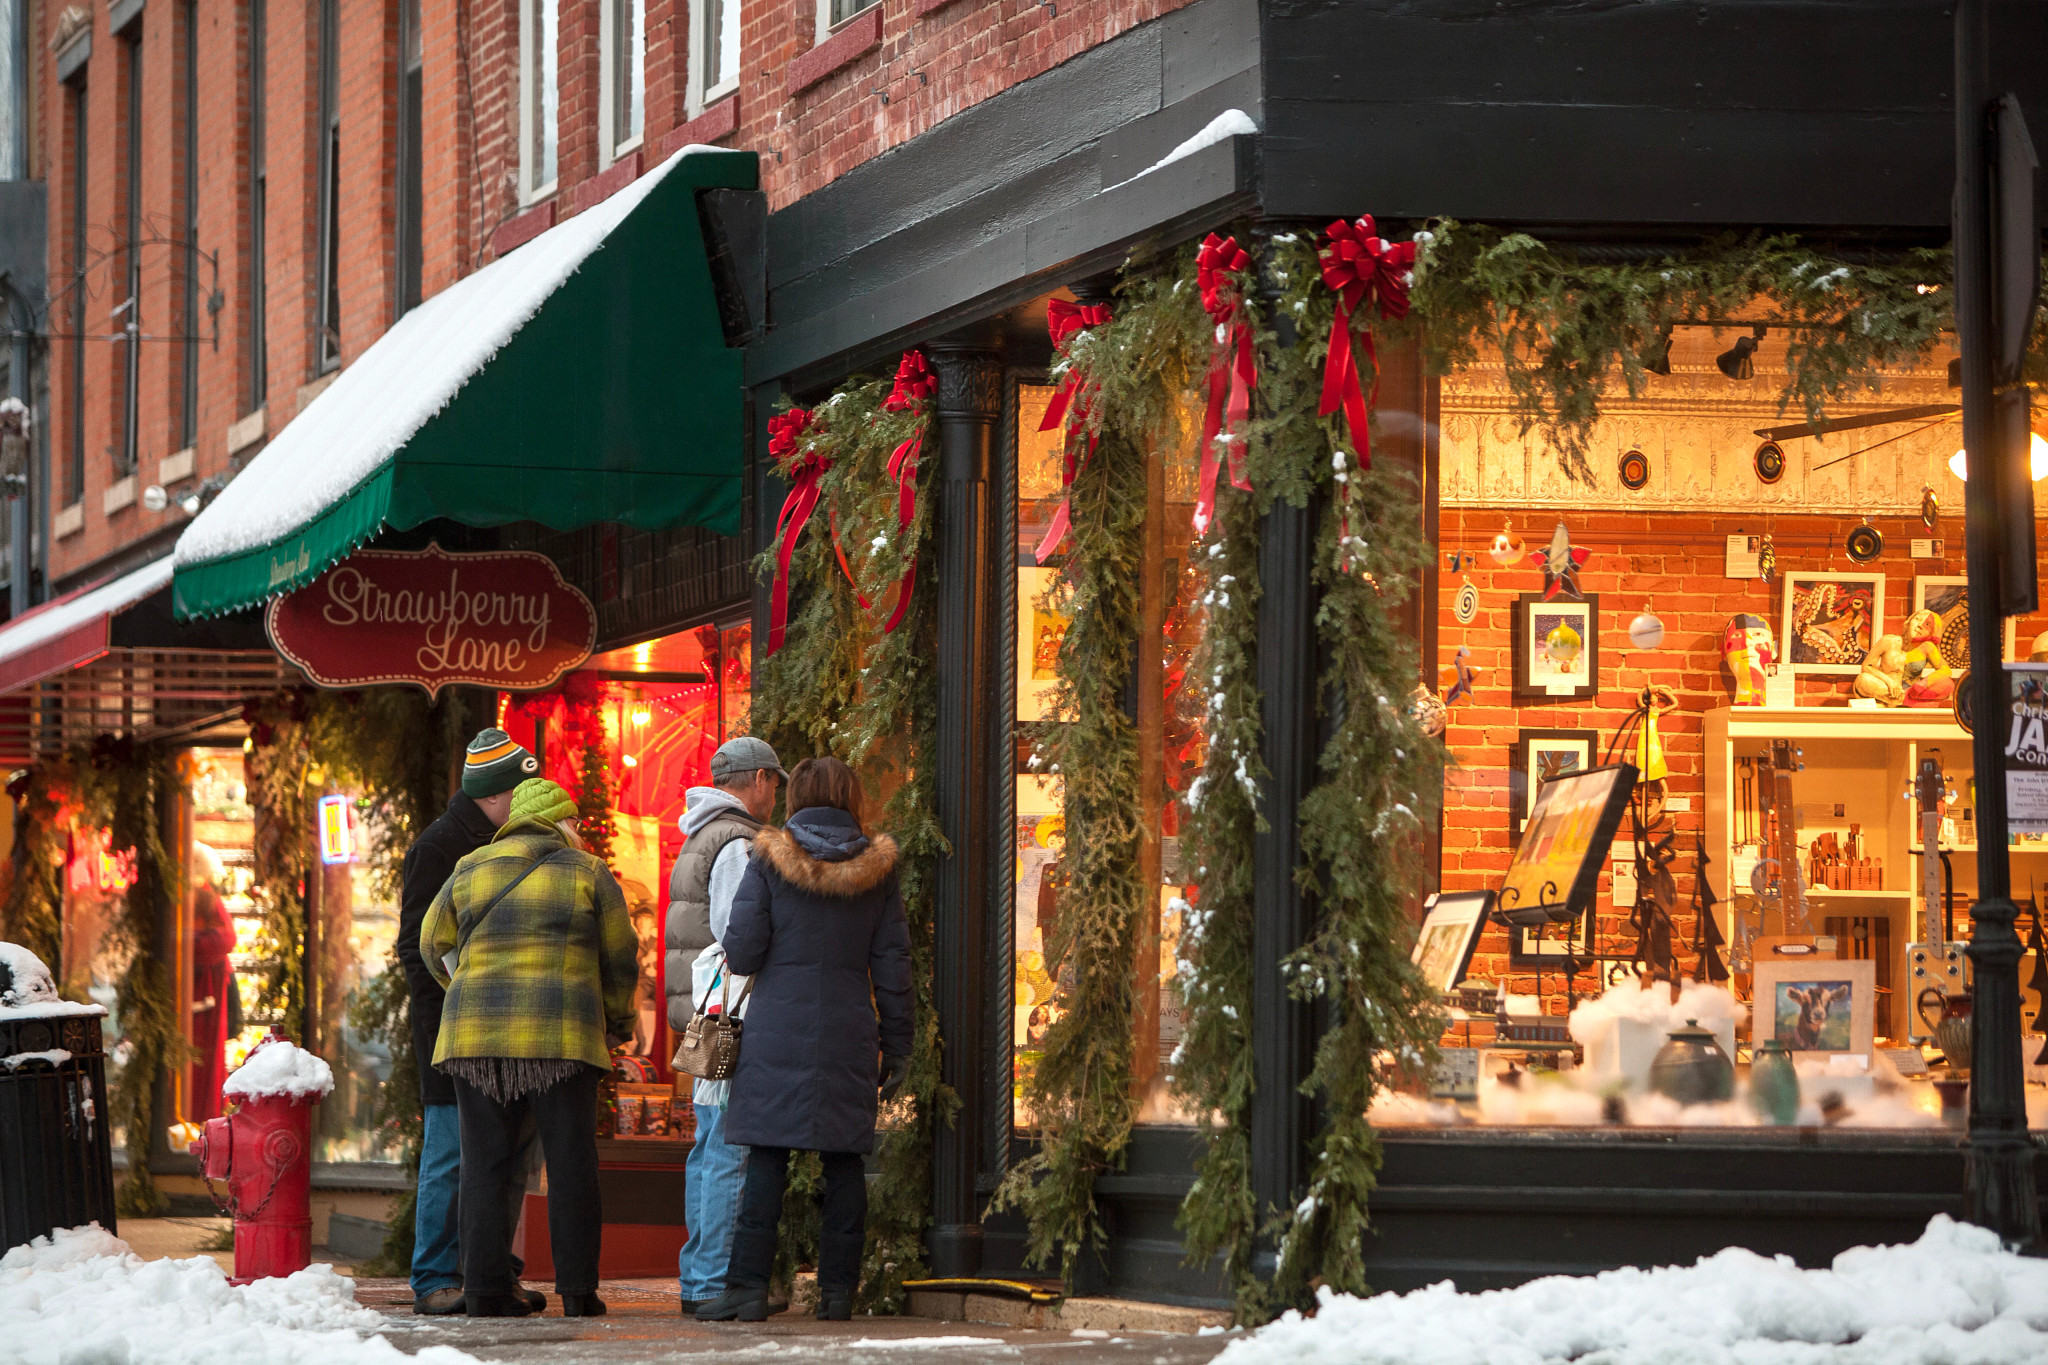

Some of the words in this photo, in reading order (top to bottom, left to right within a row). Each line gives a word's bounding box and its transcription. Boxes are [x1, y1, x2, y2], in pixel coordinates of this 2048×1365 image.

[323, 567, 552, 652] Strawberry
[416, 618, 526, 671] Lane
[2005, 715, 2048, 756] JA
[522, 756, 538, 772] G
[2016, 748, 2048, 766] con
